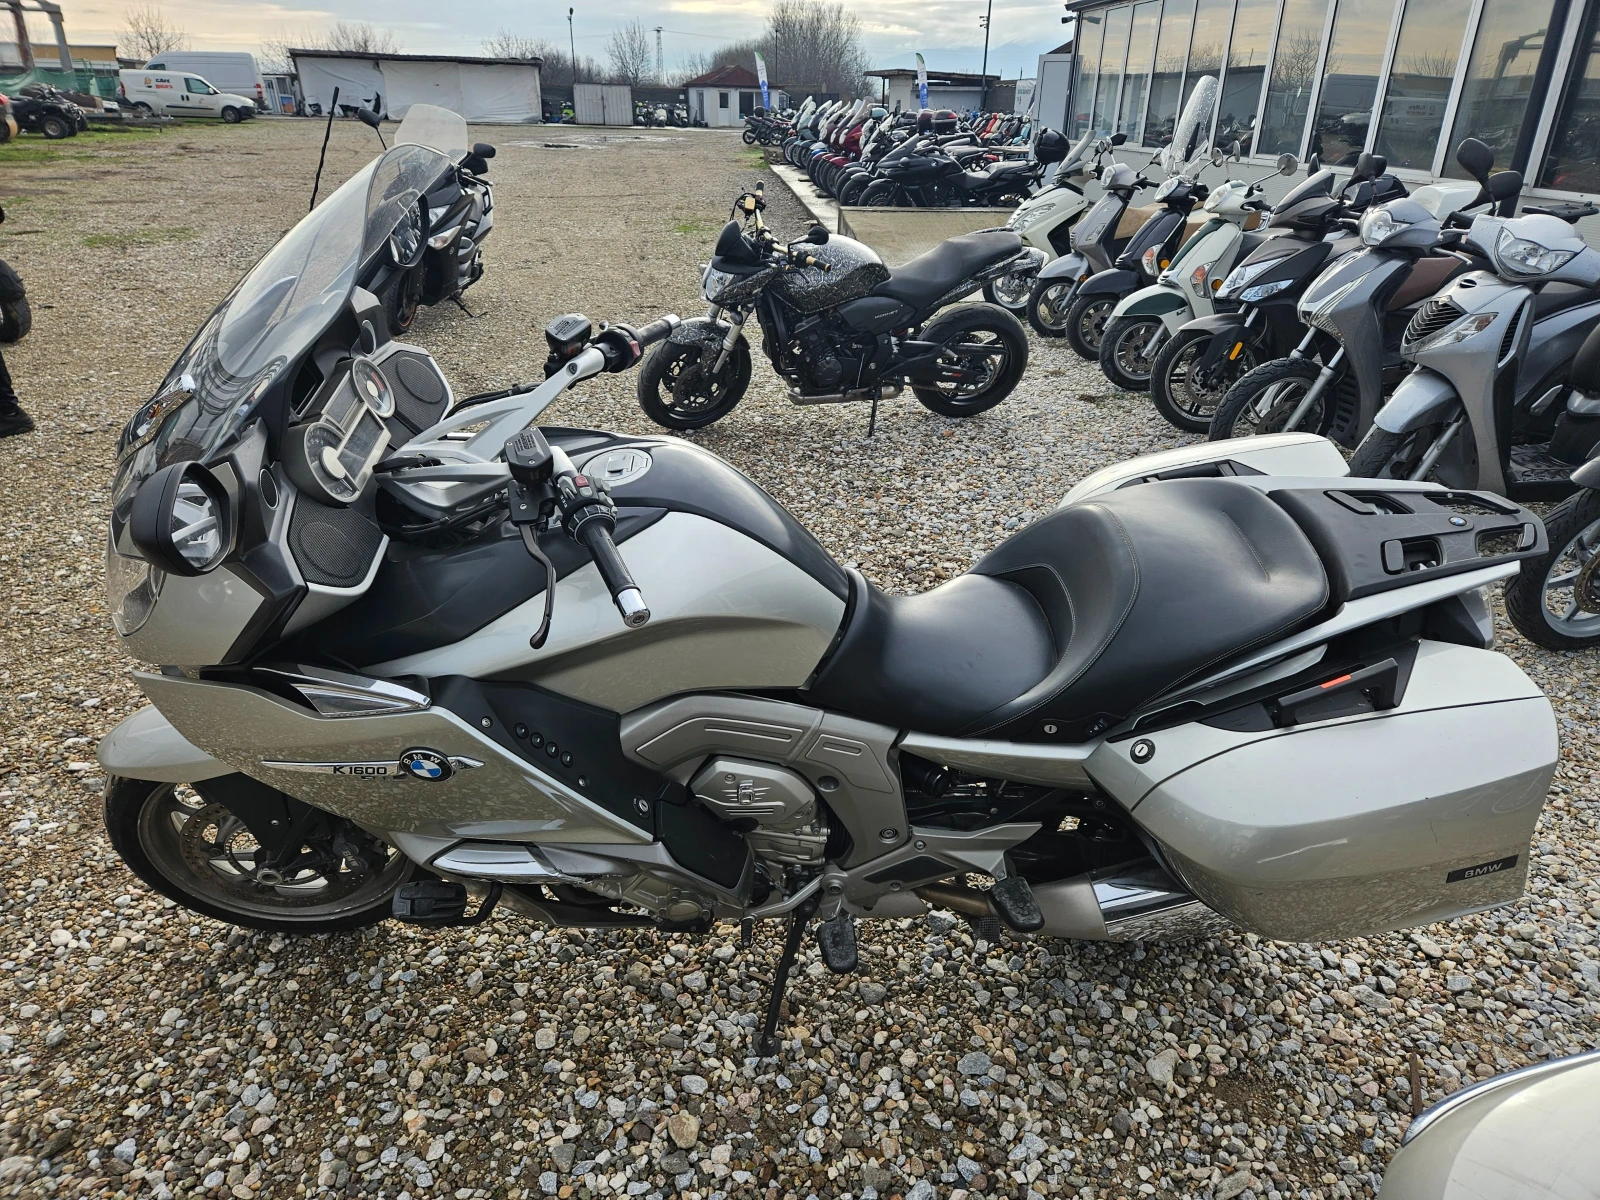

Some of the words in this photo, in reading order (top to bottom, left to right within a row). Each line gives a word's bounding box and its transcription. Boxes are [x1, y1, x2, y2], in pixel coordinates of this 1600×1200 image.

[333, 765, 345, 775] K
[349, 766, 387, 775] 1600
[1464, 862, 1502, 878] BMW
